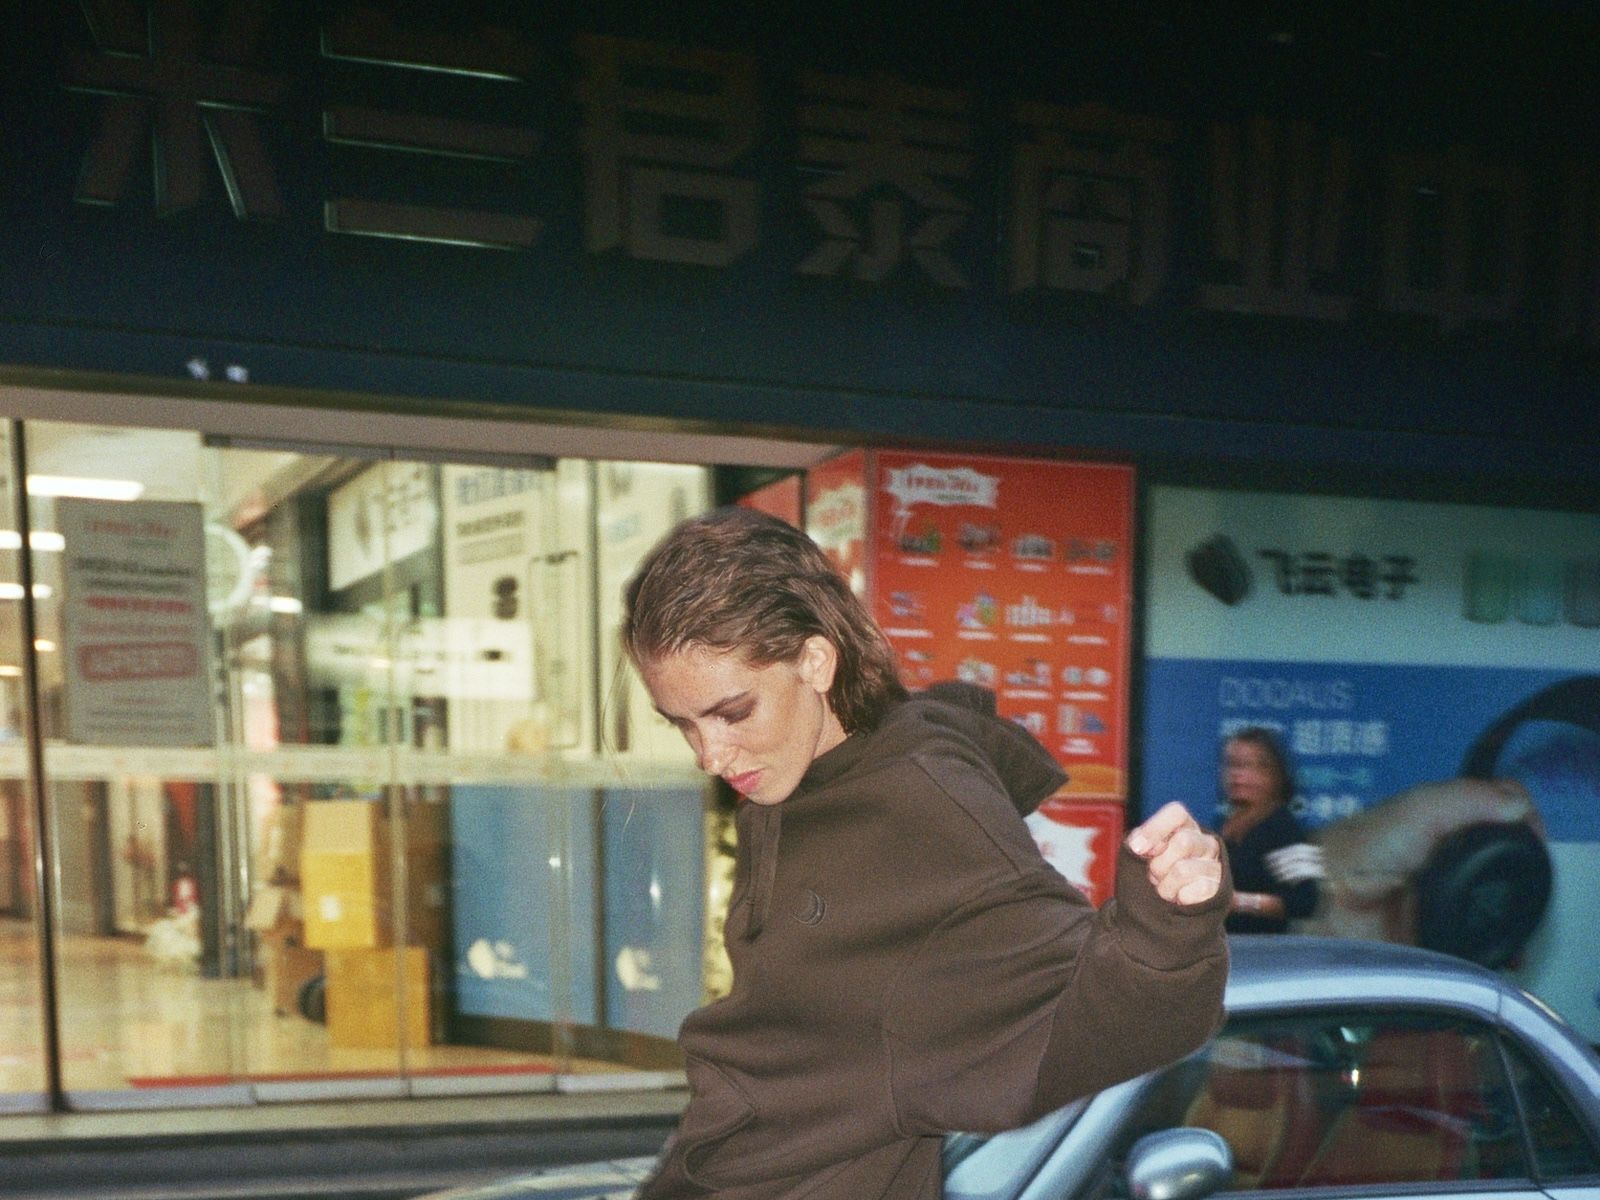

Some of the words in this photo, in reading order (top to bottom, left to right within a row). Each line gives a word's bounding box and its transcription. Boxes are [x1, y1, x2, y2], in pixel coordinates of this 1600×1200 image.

[60, 0, 1600, 345] 米兰启泰商业中
